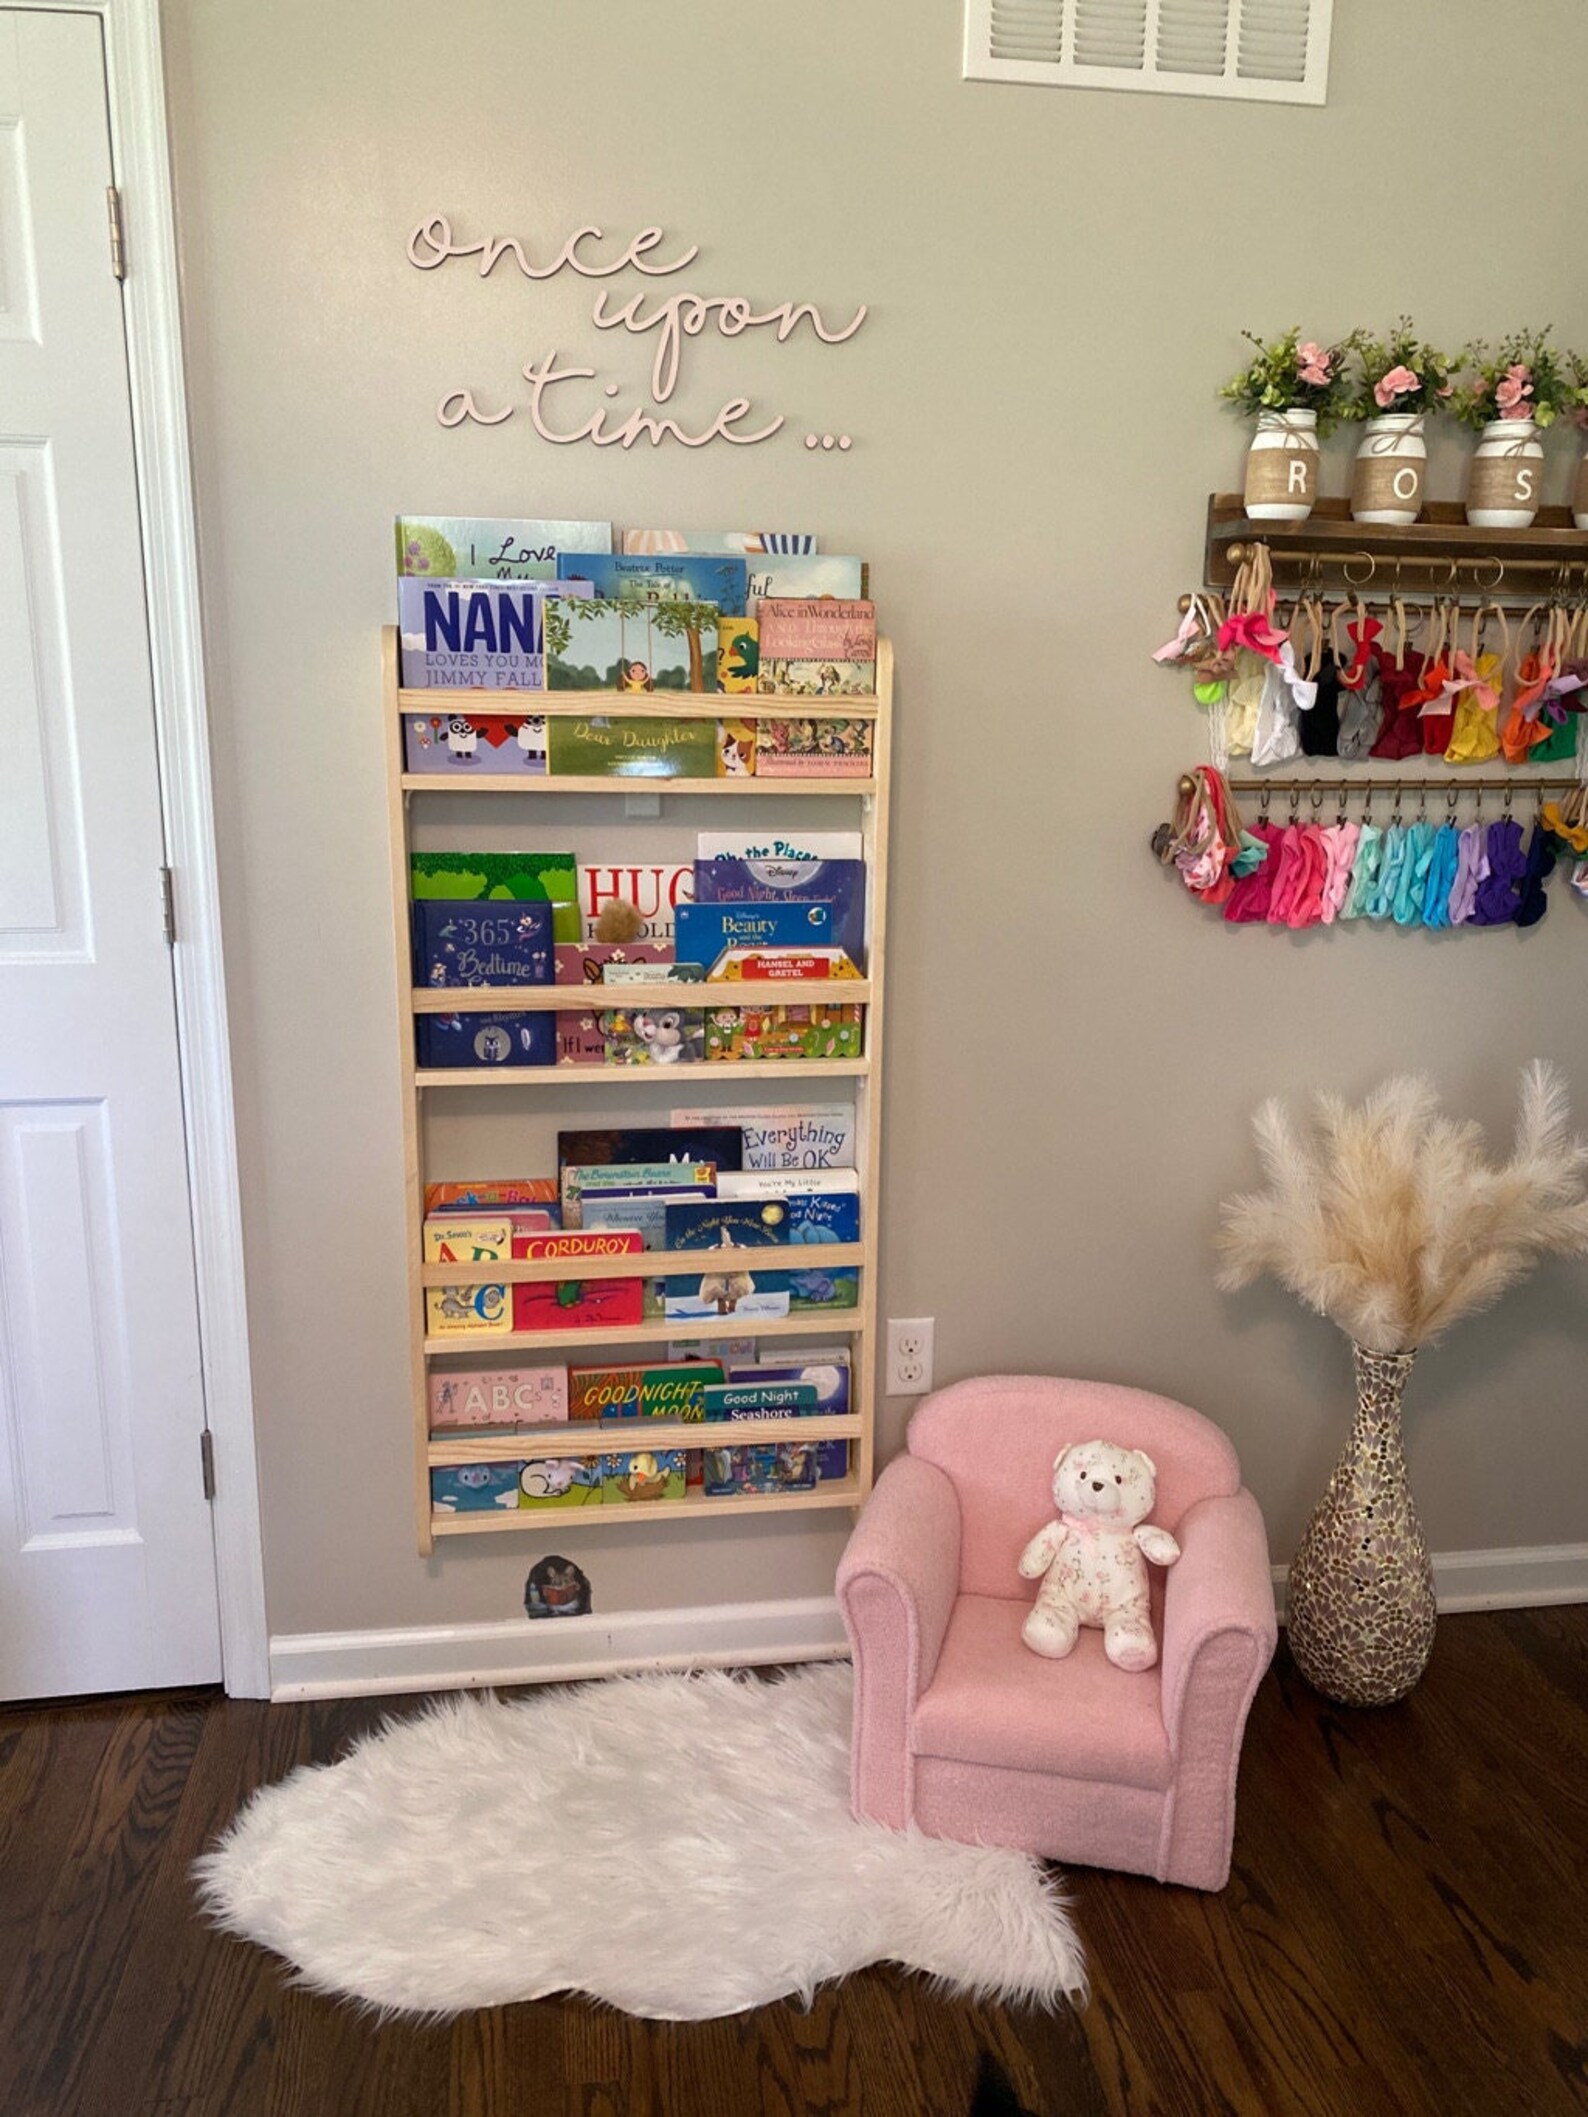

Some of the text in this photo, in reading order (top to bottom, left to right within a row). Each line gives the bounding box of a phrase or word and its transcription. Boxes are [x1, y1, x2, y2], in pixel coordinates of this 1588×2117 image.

[406, 214, 699, 279] once
[593, 291, 867, 402] upon
[437, 389, 514, 427] a
[522, 349, 785, 448] time
[1288, 460, 1534, 501] R O S
[470, 536, 556, 566] I Love
[424, 591, 544, 654] NAN
[426, 653, 479, 667] LOVES
[484, 655, 519, 668] YOU
[426, 669, 543, 687] JIMMY FALL
[573, 721, 696, 753] Dear Daughter
[745, 846, 769, 858] the
[765, 865, 798, 879] Disney
[464, 919, 510, 945] 365
[722, 915, 777, 936] Beauty
[457, 948, 532, 978] Bedtime
[757, 960, 793, 968] HANSEL
[768, 969, 804, 977] GRETEL
[743, 1120, 846, 1155] Everything
[748, 1149, 832, 1169] Will Be OK
[527, 1238, 631, 1262] CORDUROY
[583, 1380, 702, 1407] GOODNIGHT
[723, 1391, 800, 1405] Good Night
[730, 1407, 793, 1421] Seashore
